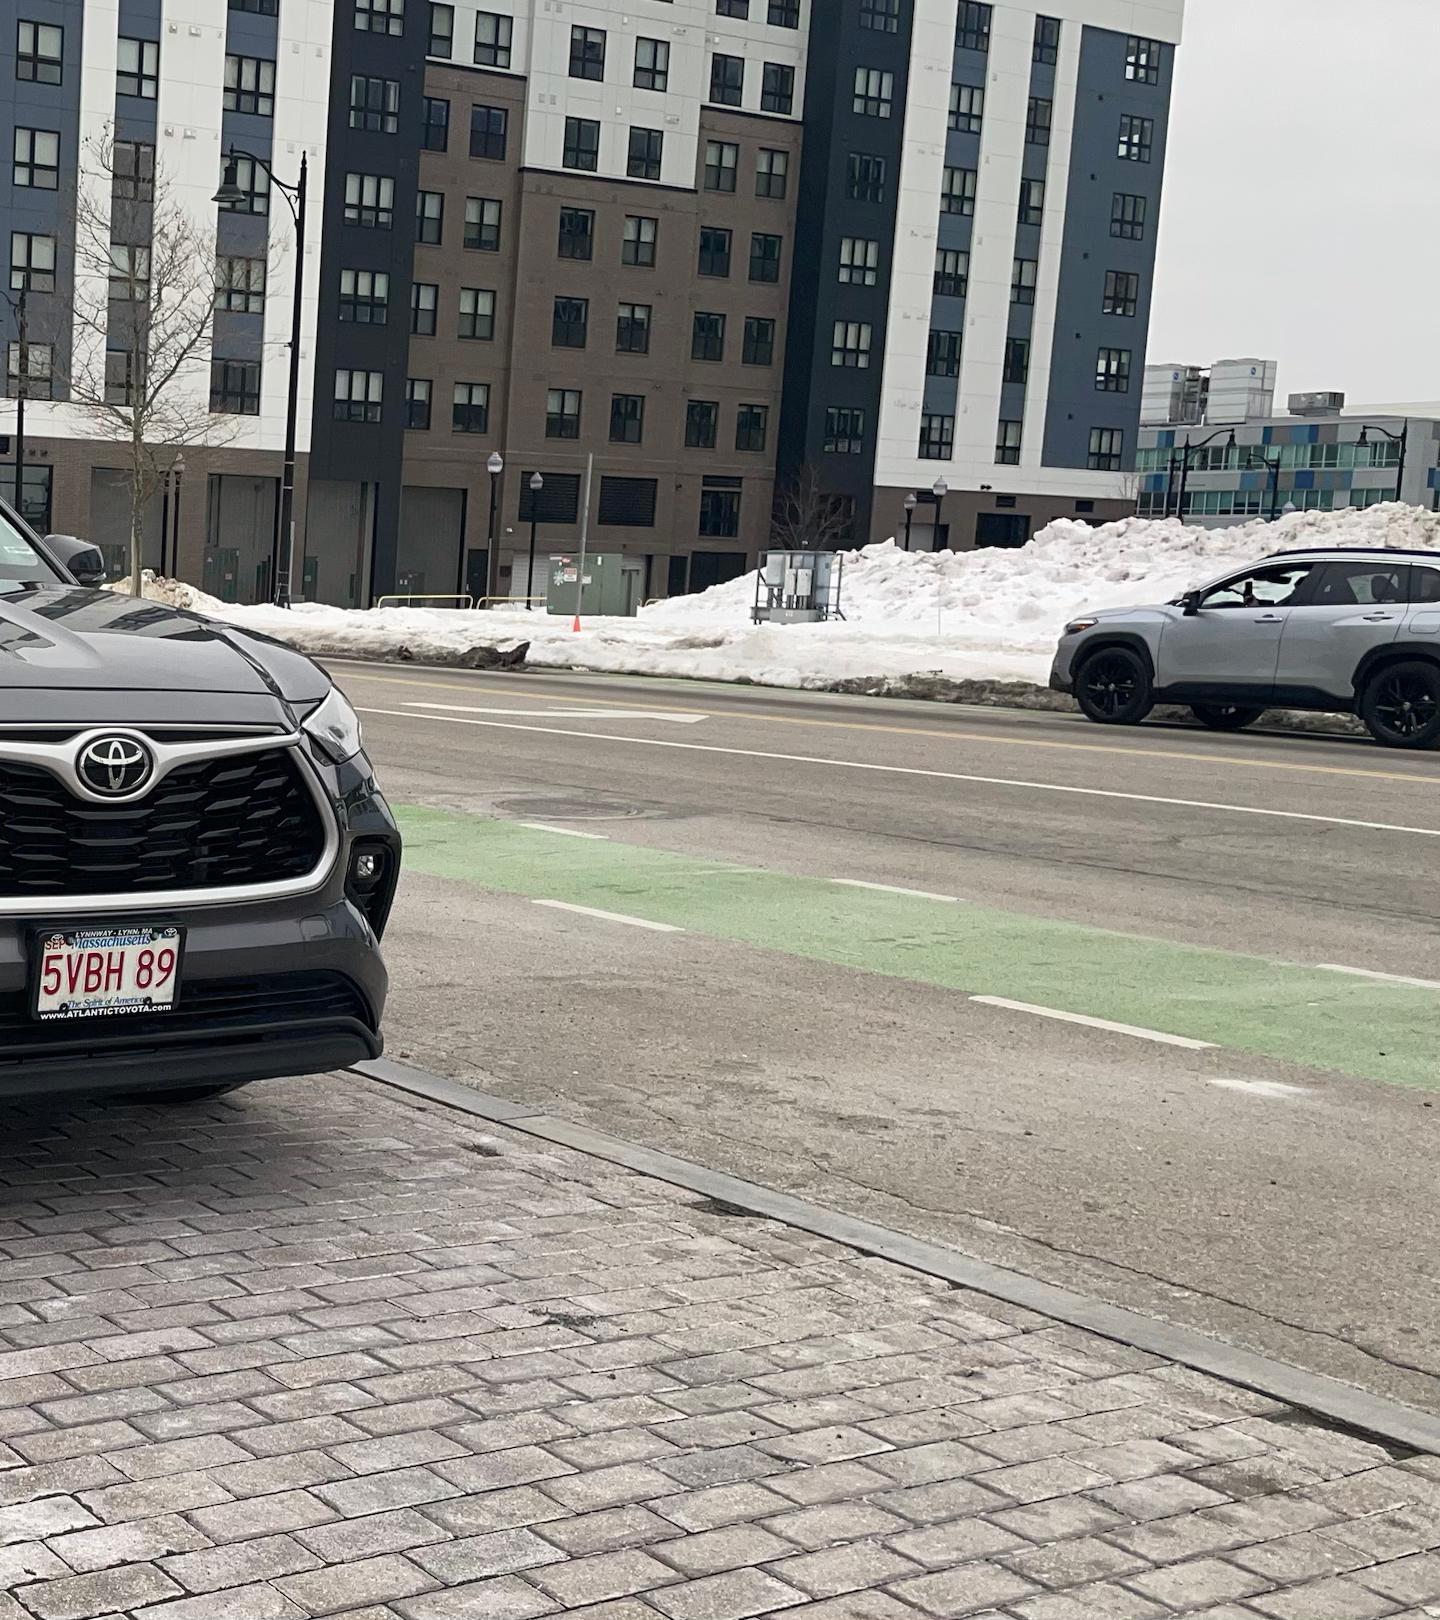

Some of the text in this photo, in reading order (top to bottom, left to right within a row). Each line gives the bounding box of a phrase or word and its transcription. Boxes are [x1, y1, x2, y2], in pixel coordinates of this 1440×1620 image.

[75, 930, 114, 939] LYNNWAY
[45, 939, 65, 950] SEP
[72, 934, 151, 950] Massachusetts
[43, 948, 175, 996] 5VBH 89
[67, 996, 145, 1009] The Spirit of America
[40, 1004, 172, 1021] www.ATLANTICTOYOTA.com
